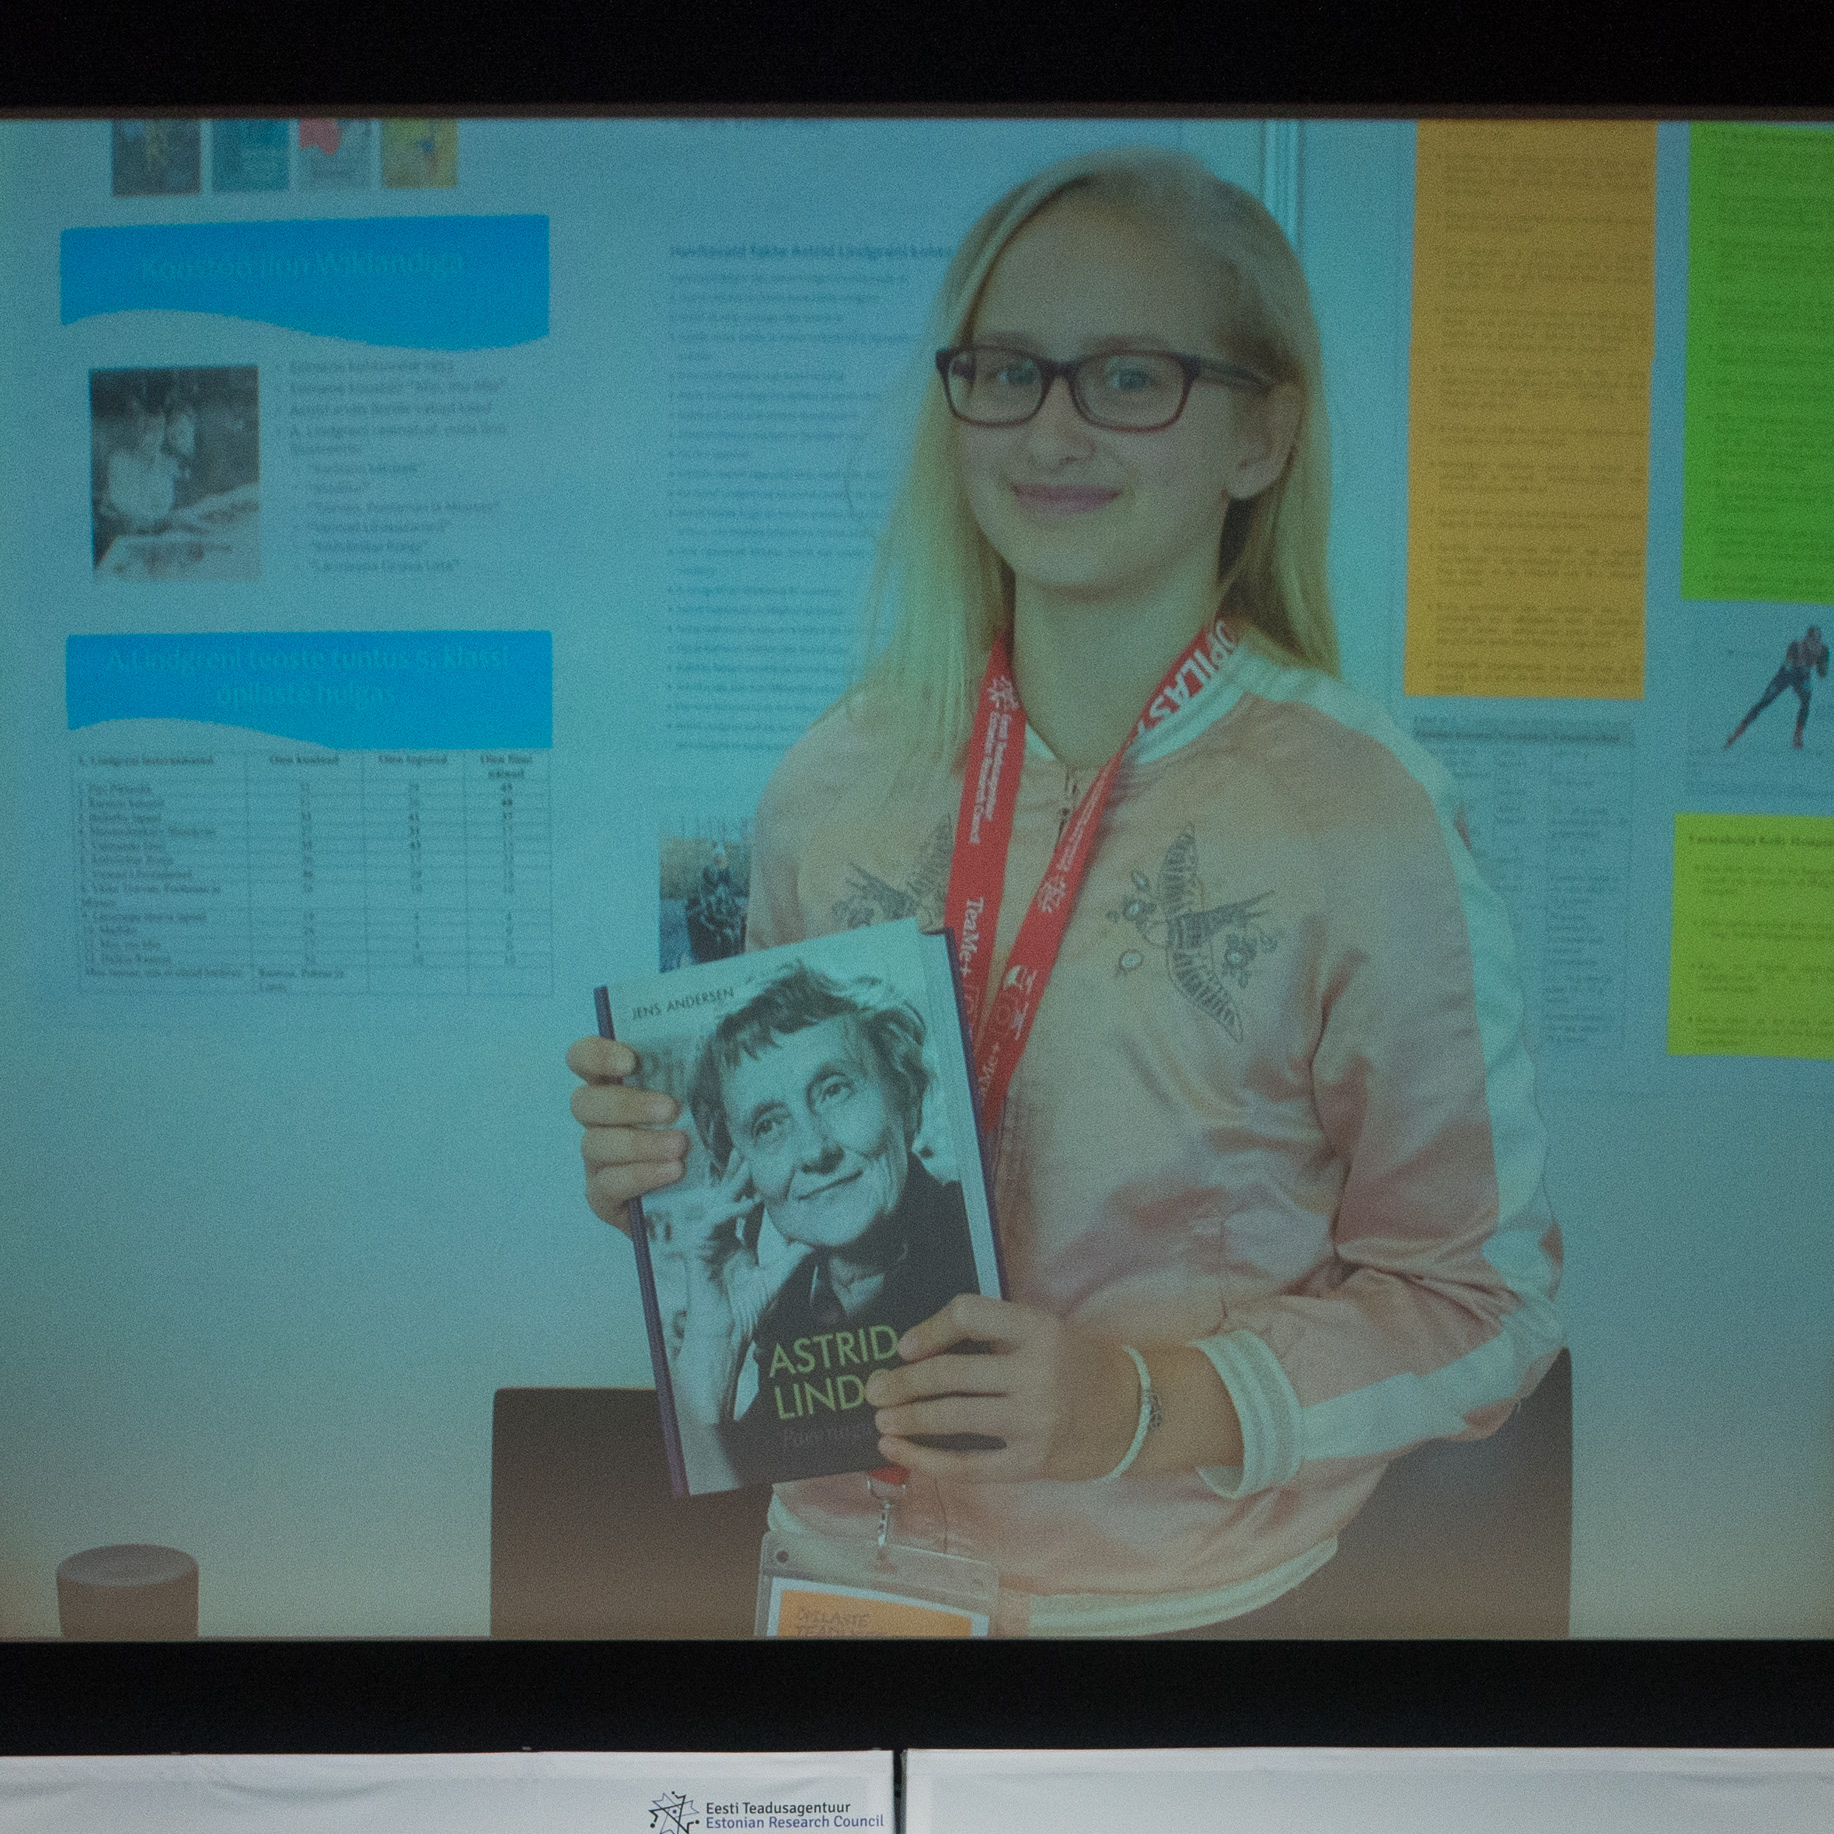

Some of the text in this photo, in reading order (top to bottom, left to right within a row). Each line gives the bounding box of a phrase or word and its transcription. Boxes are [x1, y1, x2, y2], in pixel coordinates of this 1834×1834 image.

[631, 987, 735, 1021] JENS ANDERSEN
[768, 1326, 899, 1378] ASTRID
[774, 1370, 875, 1420] LIND
[706, 1802, 851, 1816] Eesti Teadusagentuur
[706, 1814, 883, 1829] Estonian Research Council
